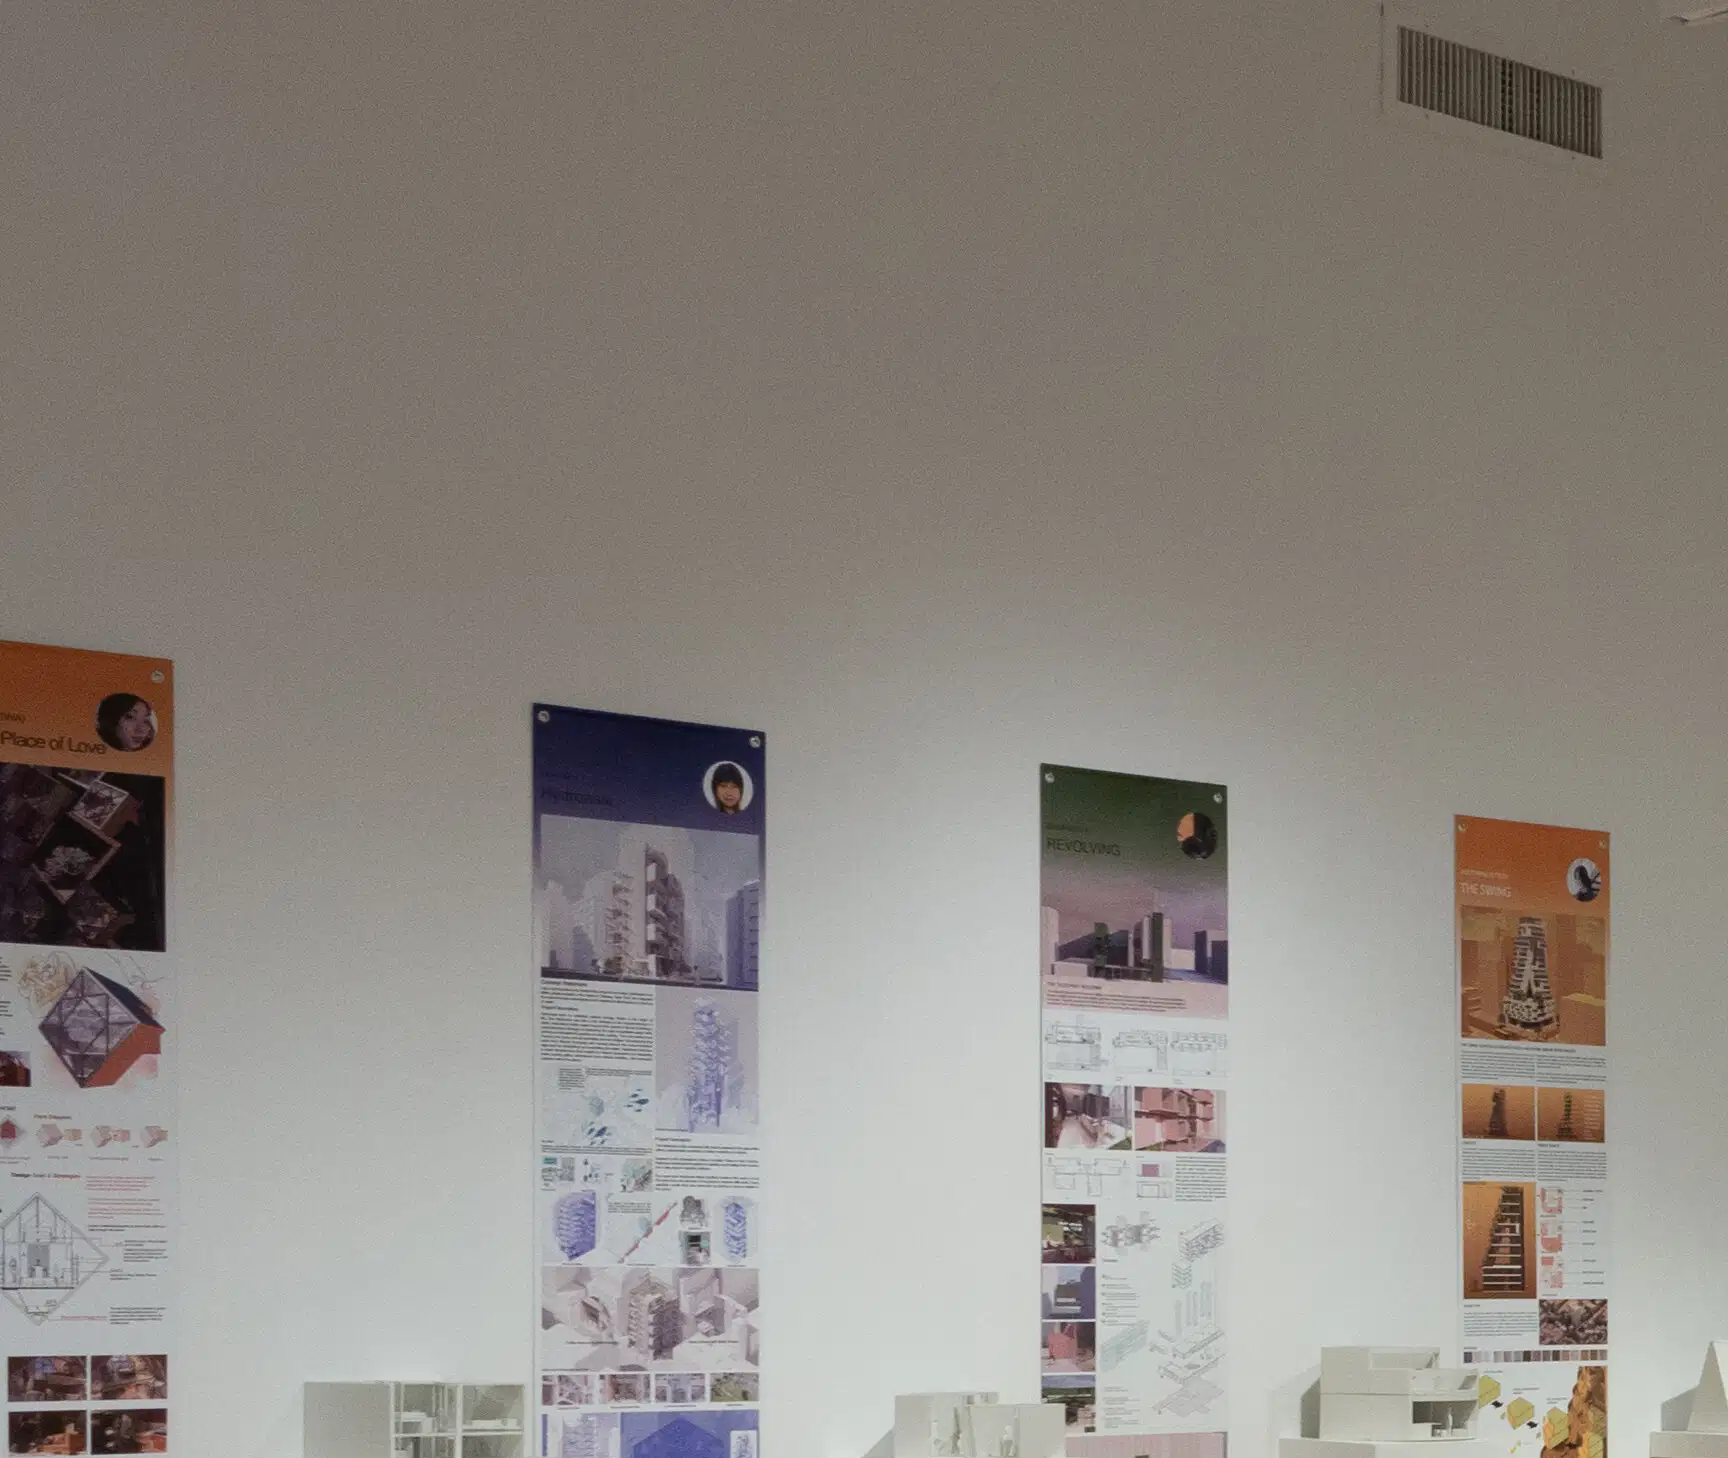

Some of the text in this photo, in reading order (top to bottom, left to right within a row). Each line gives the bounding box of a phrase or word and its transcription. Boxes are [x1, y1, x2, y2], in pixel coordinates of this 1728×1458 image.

[1, 730, 106, 755] Place of Love
[1046, 837, 1121, 857] REVOLVING
[1459, 882, 1512, 899] THE SWING
